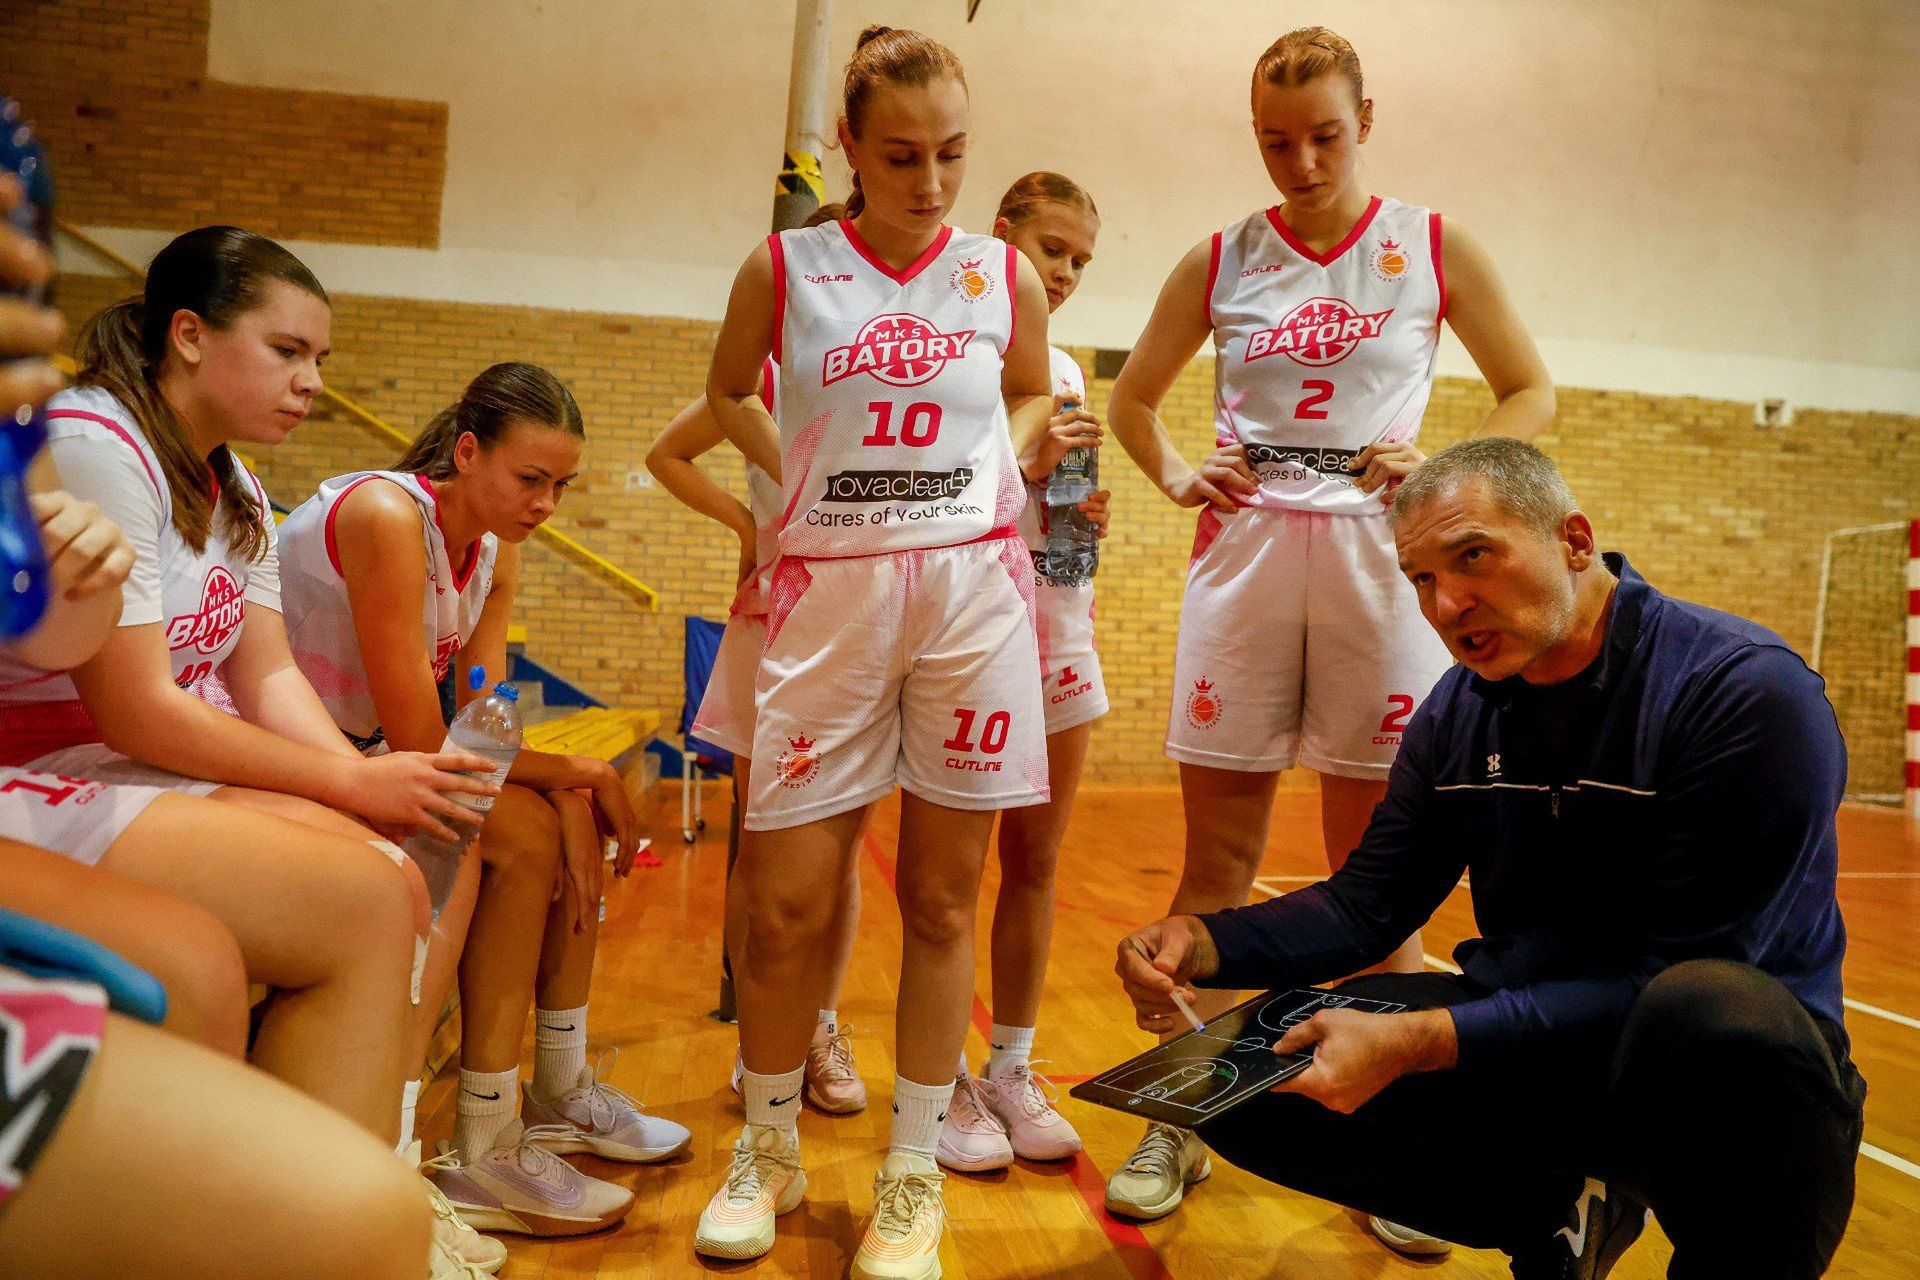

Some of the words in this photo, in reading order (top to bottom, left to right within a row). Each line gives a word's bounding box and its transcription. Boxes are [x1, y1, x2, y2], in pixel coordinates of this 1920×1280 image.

[1299, 309, 1340, 323] MKS
[876, 327, 922, 339] MKS
[1252, 313, 1387, 354] BATORY
[827, 331, 974, 383] BATORY
[1294, 379, 1335, 420] 2
[862, 401, 943, 448] 10
[807, 509, 864, 526] Cares
[871, 507, 890, 524] of
[897, 505, 941, 522] Your
[944, 503, 984, 516] skin
[209, 588, 230, 609] MKS
[167, 597, 243, 647] BATOR
[1051, 681, 1093, 704] CUTLINE
[1380, 694, 1414, 732] 2
[943, 708, 1010, 755] 10
[1372, 736, 1403, 745] CUTL
[945, 757, 1003, 773] CUTLINE
